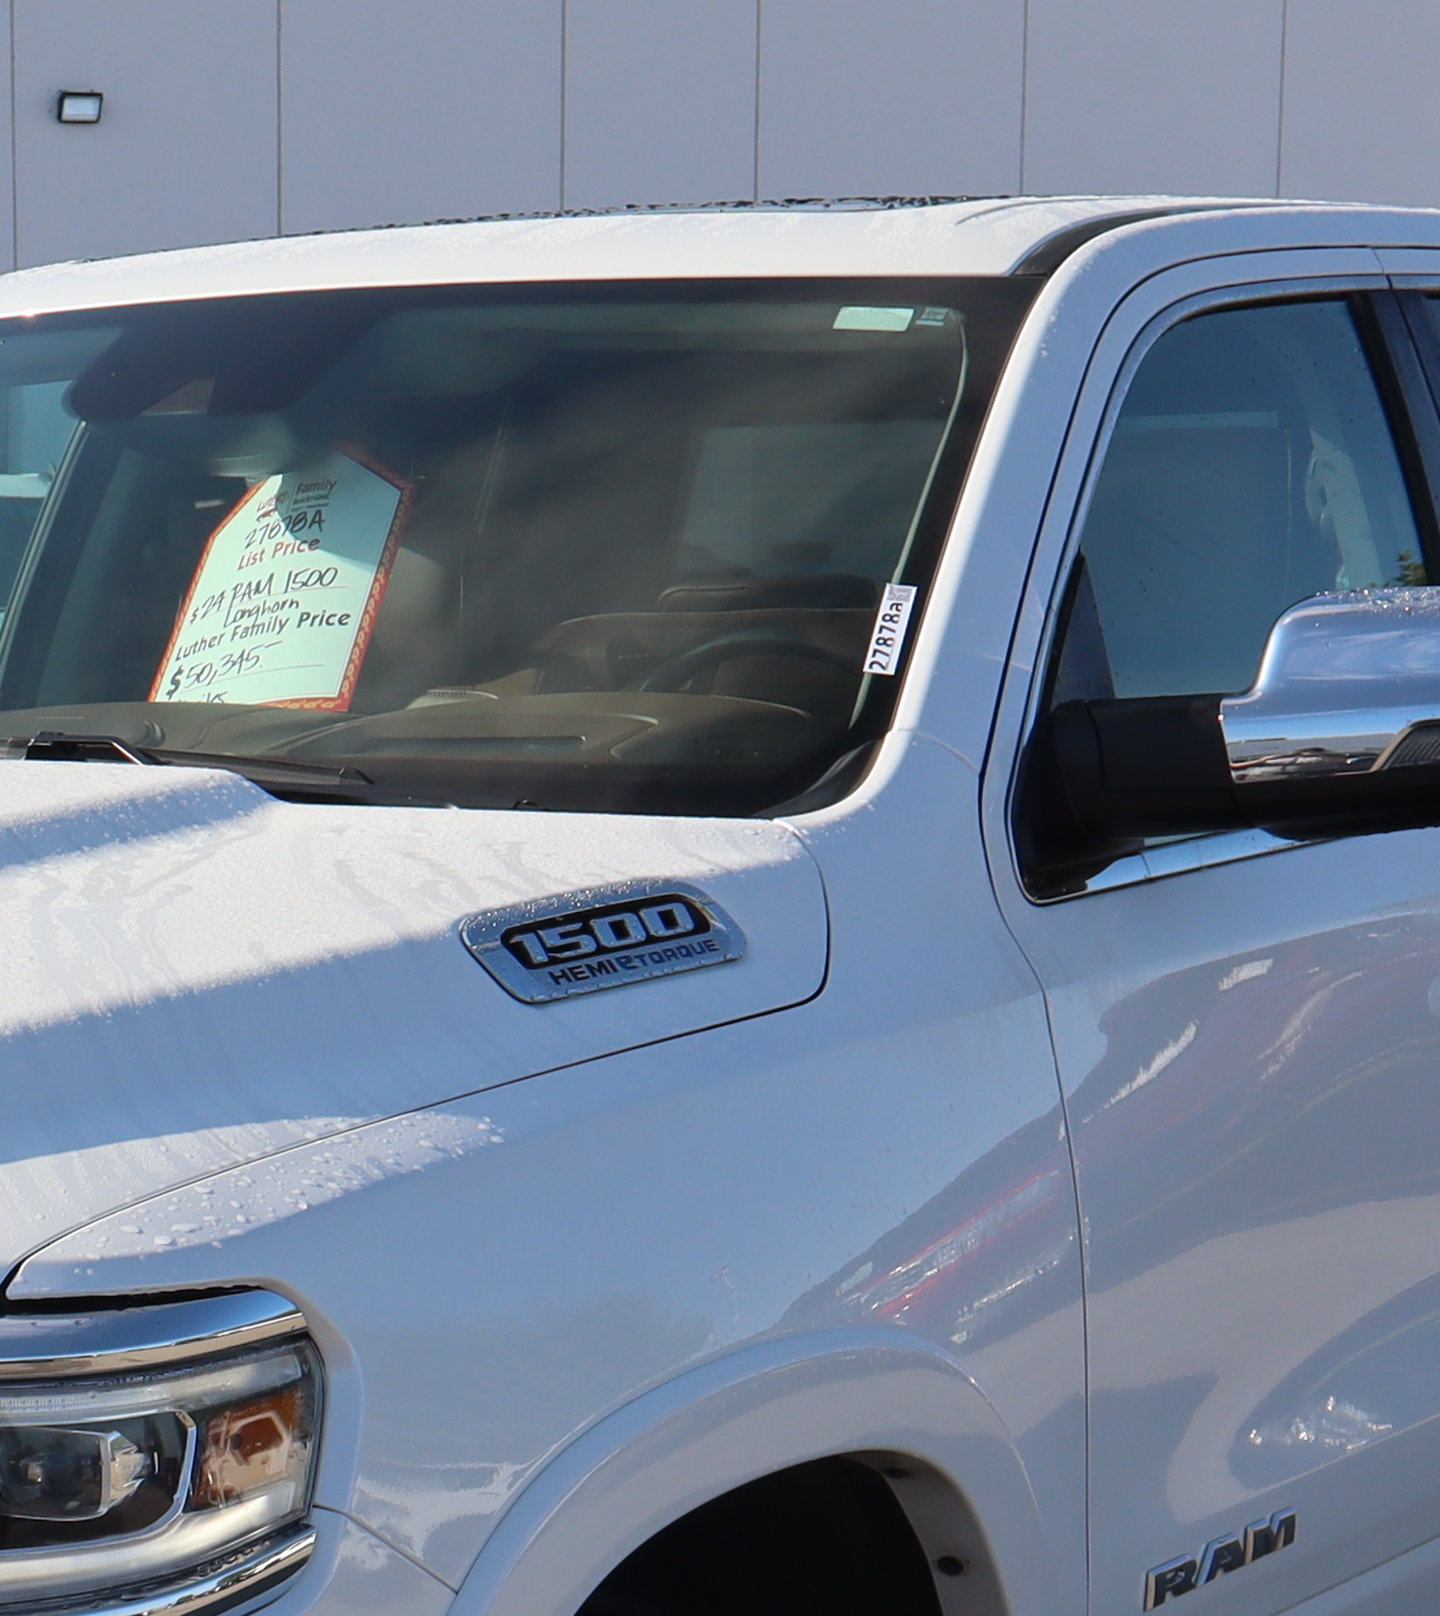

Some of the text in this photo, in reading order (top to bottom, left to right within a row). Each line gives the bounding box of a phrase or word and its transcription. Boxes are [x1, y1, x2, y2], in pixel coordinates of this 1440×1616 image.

[238, 537, 320, 571] List Price
[284, 567, 338, 594] 1500
[175, 609, 351, 662] Luther Family Price
[868, 602, 904, 671] 27878a
[509, 901, 695, 965] 1500
[546, 958, 618, 986] HEMI
[1142, 1505, 1297, 1613] RAM
